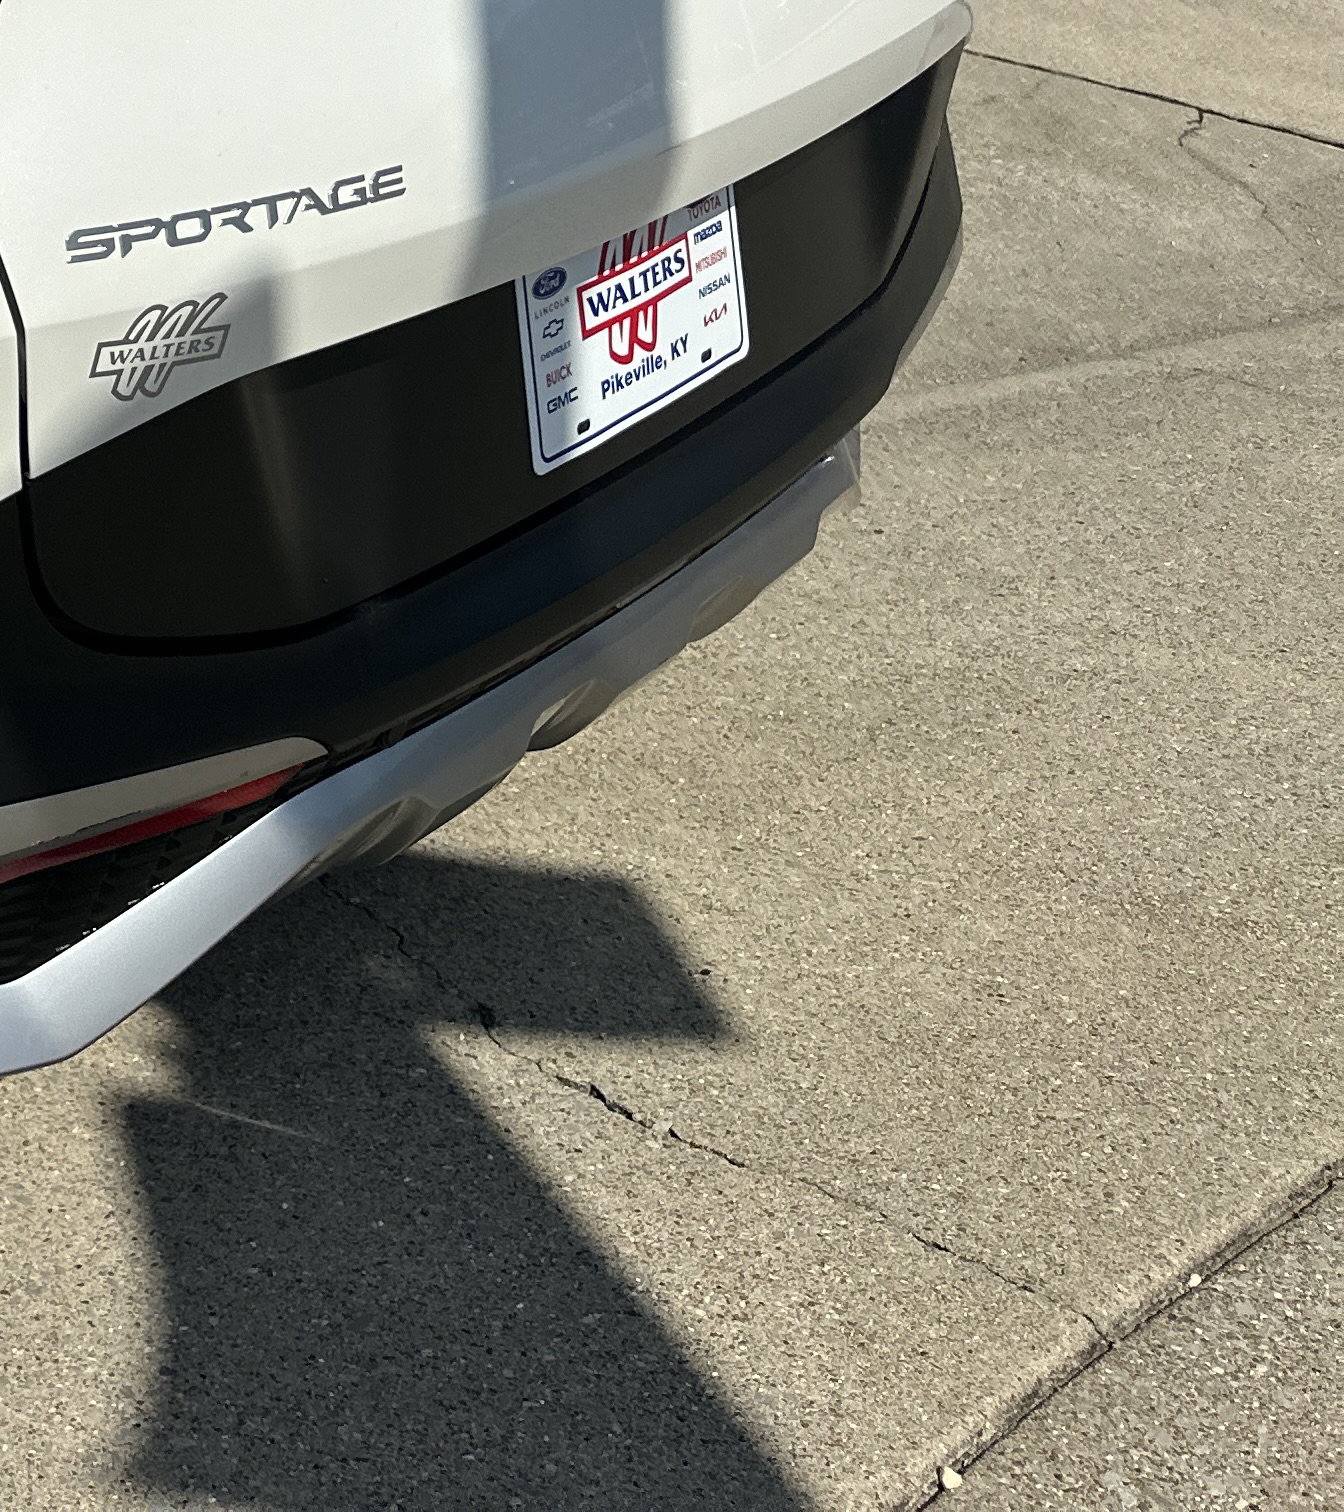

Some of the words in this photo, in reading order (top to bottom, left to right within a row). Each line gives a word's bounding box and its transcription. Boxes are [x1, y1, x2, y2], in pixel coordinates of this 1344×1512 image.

[64, 164, 407, 264] SPORTAGE
[687, 195, 722, 222] TOYOTA
[693, 220, 723, 245] mazda
[695, 246, 728, 274] MITSUBISHI
[585, 248, 686, 318] WALTERS
[698, 272, 731, 300] NISSAN
[533, 295, 571, 320] LINCOLN
[108, 334, 217, 367] WALTERS
[545, 362, 574, 388] BUICK
[600, 353, 668, 401] Pikeville,
[669, 333, 690, 361] KY
[546, 386, 579, 415] GMC
